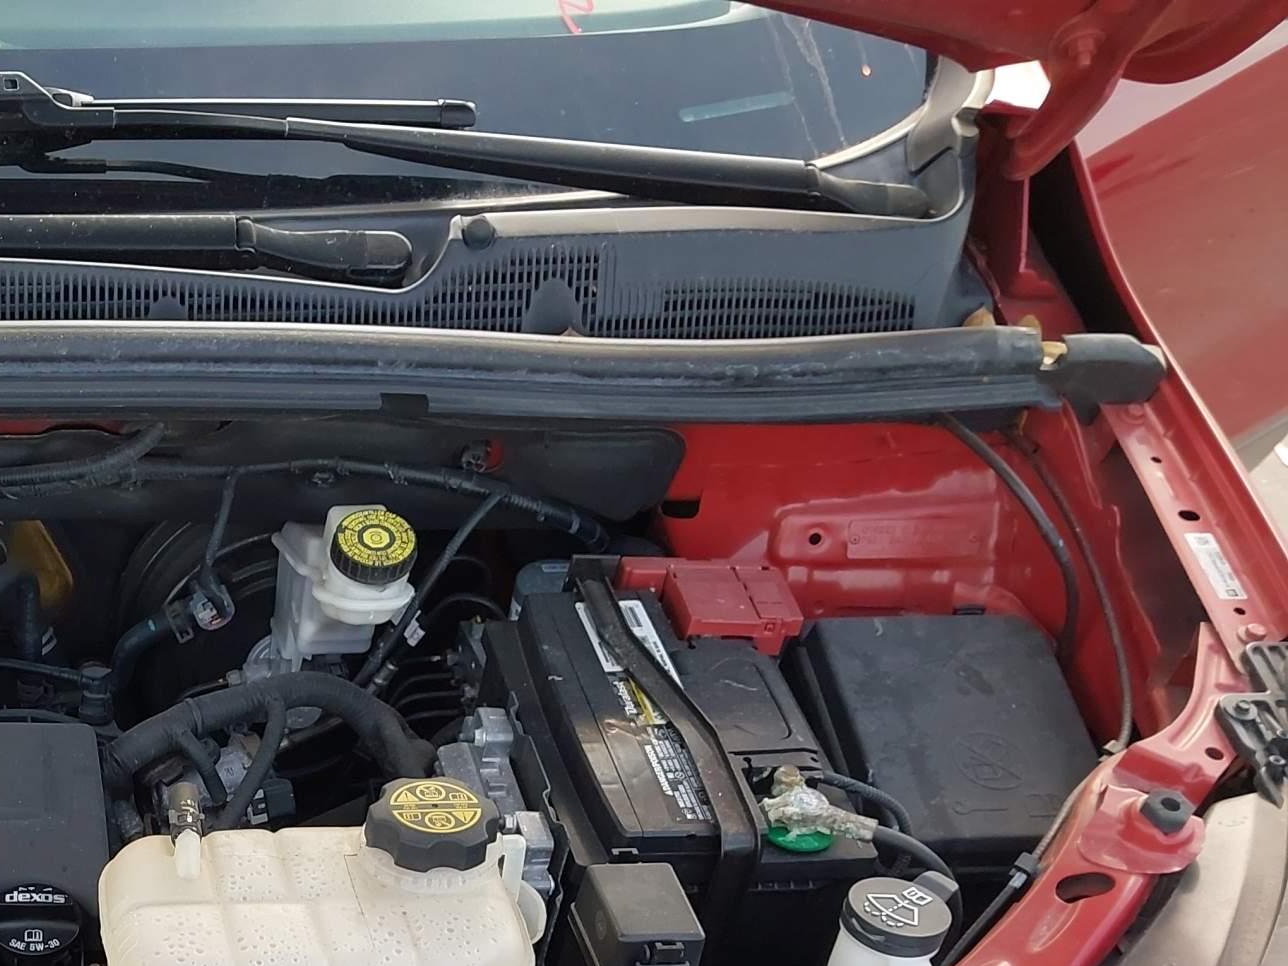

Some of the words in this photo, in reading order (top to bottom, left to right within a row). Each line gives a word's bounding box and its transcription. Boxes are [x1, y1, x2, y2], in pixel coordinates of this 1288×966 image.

[5, 890, 66, 904] dexos
[9, 938, 27, 951] SAE
[29, 938, 61, 952] 5W-30
